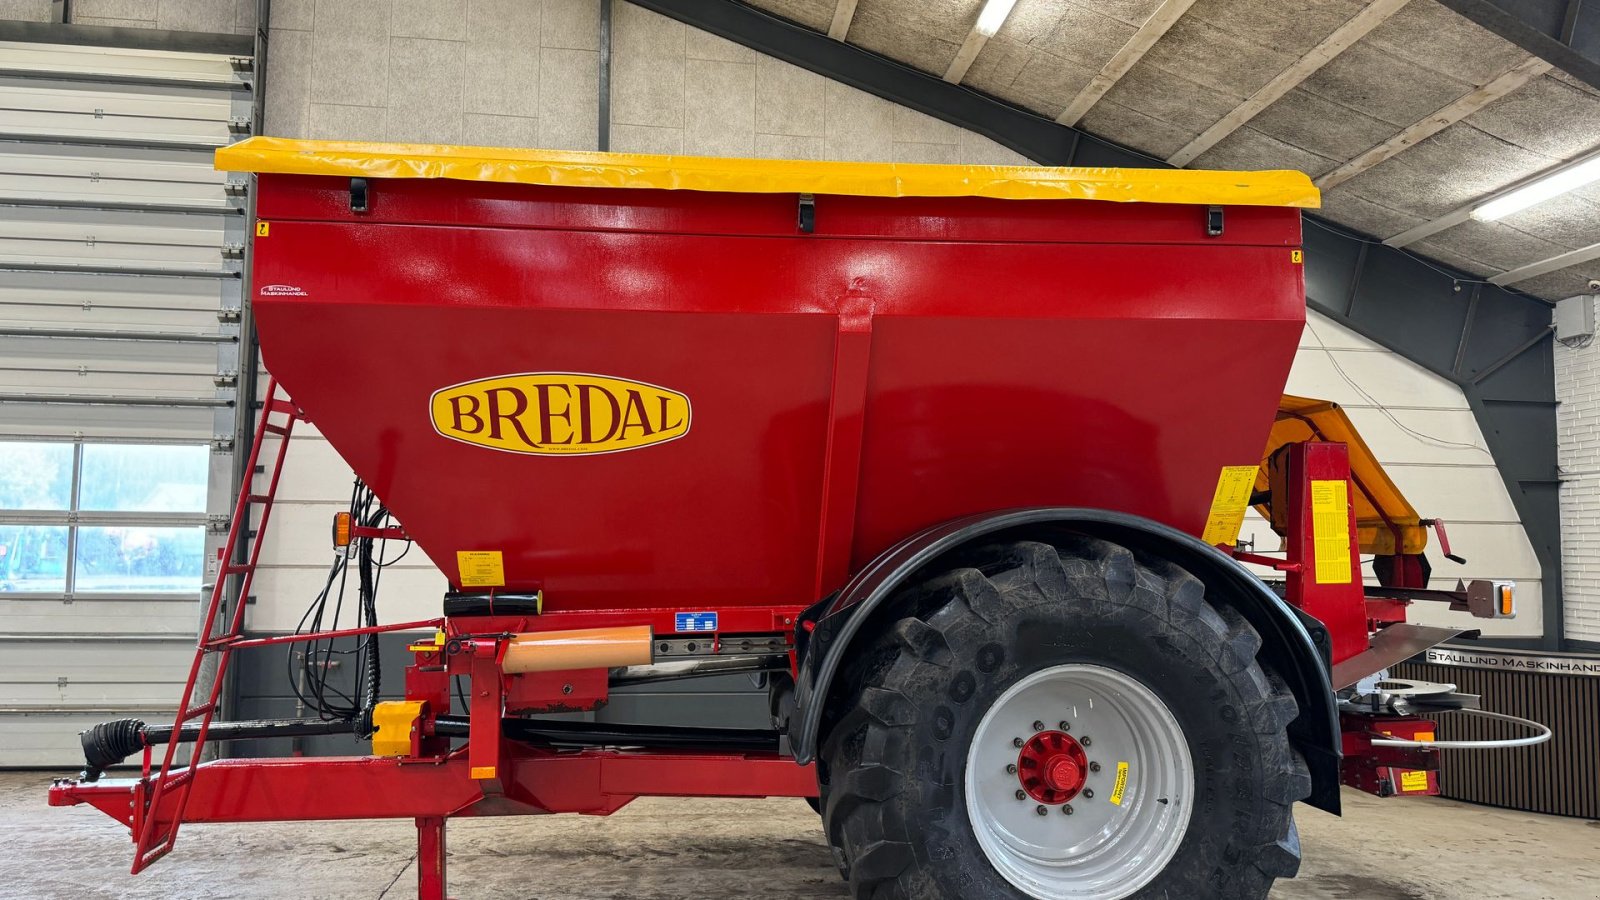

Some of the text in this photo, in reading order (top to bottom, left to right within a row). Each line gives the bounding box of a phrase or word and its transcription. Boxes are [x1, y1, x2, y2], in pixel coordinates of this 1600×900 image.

[448, 383, 683, 449] BREDAL
[1428, 652, 1498, 666] STAULUND
[1117, 767, 1127, 799] IMPORTANT
